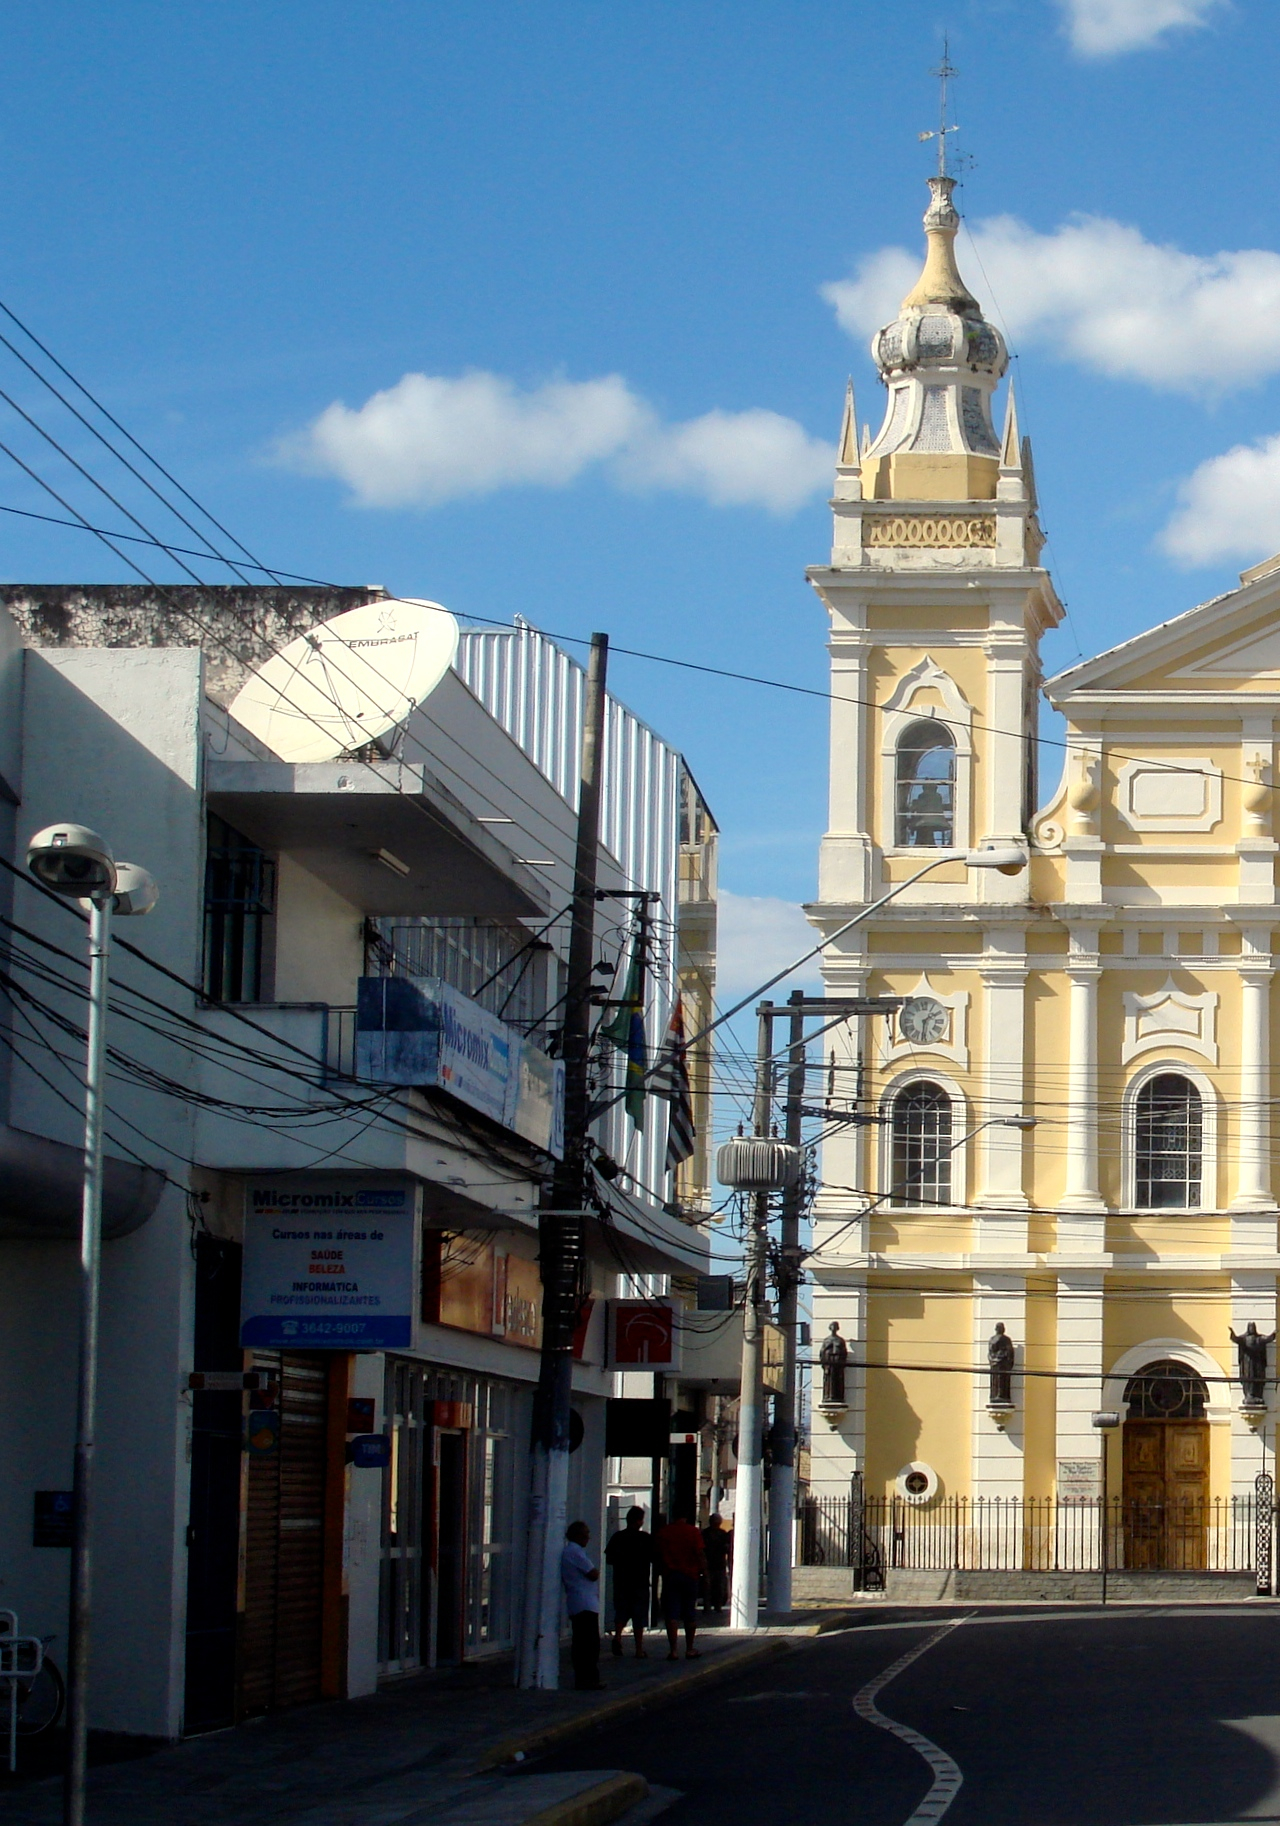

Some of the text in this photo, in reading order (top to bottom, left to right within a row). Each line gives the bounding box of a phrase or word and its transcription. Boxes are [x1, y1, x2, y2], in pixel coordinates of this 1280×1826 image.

[349, 631, 420, 648] EMBRASAT
[444, 1003, 489, 1071] Micromix
[253, 1190, 405, 1207] Micromix Cursos
[272, 1229, 384, 1240] Cursos nas áreas de
[309, 1264, 345, 1274] BELEZA
[270, 1295, 381, 1306] PROFISSIONALIZANTES
[301, 1322, 367, 1334] 3642-9007
